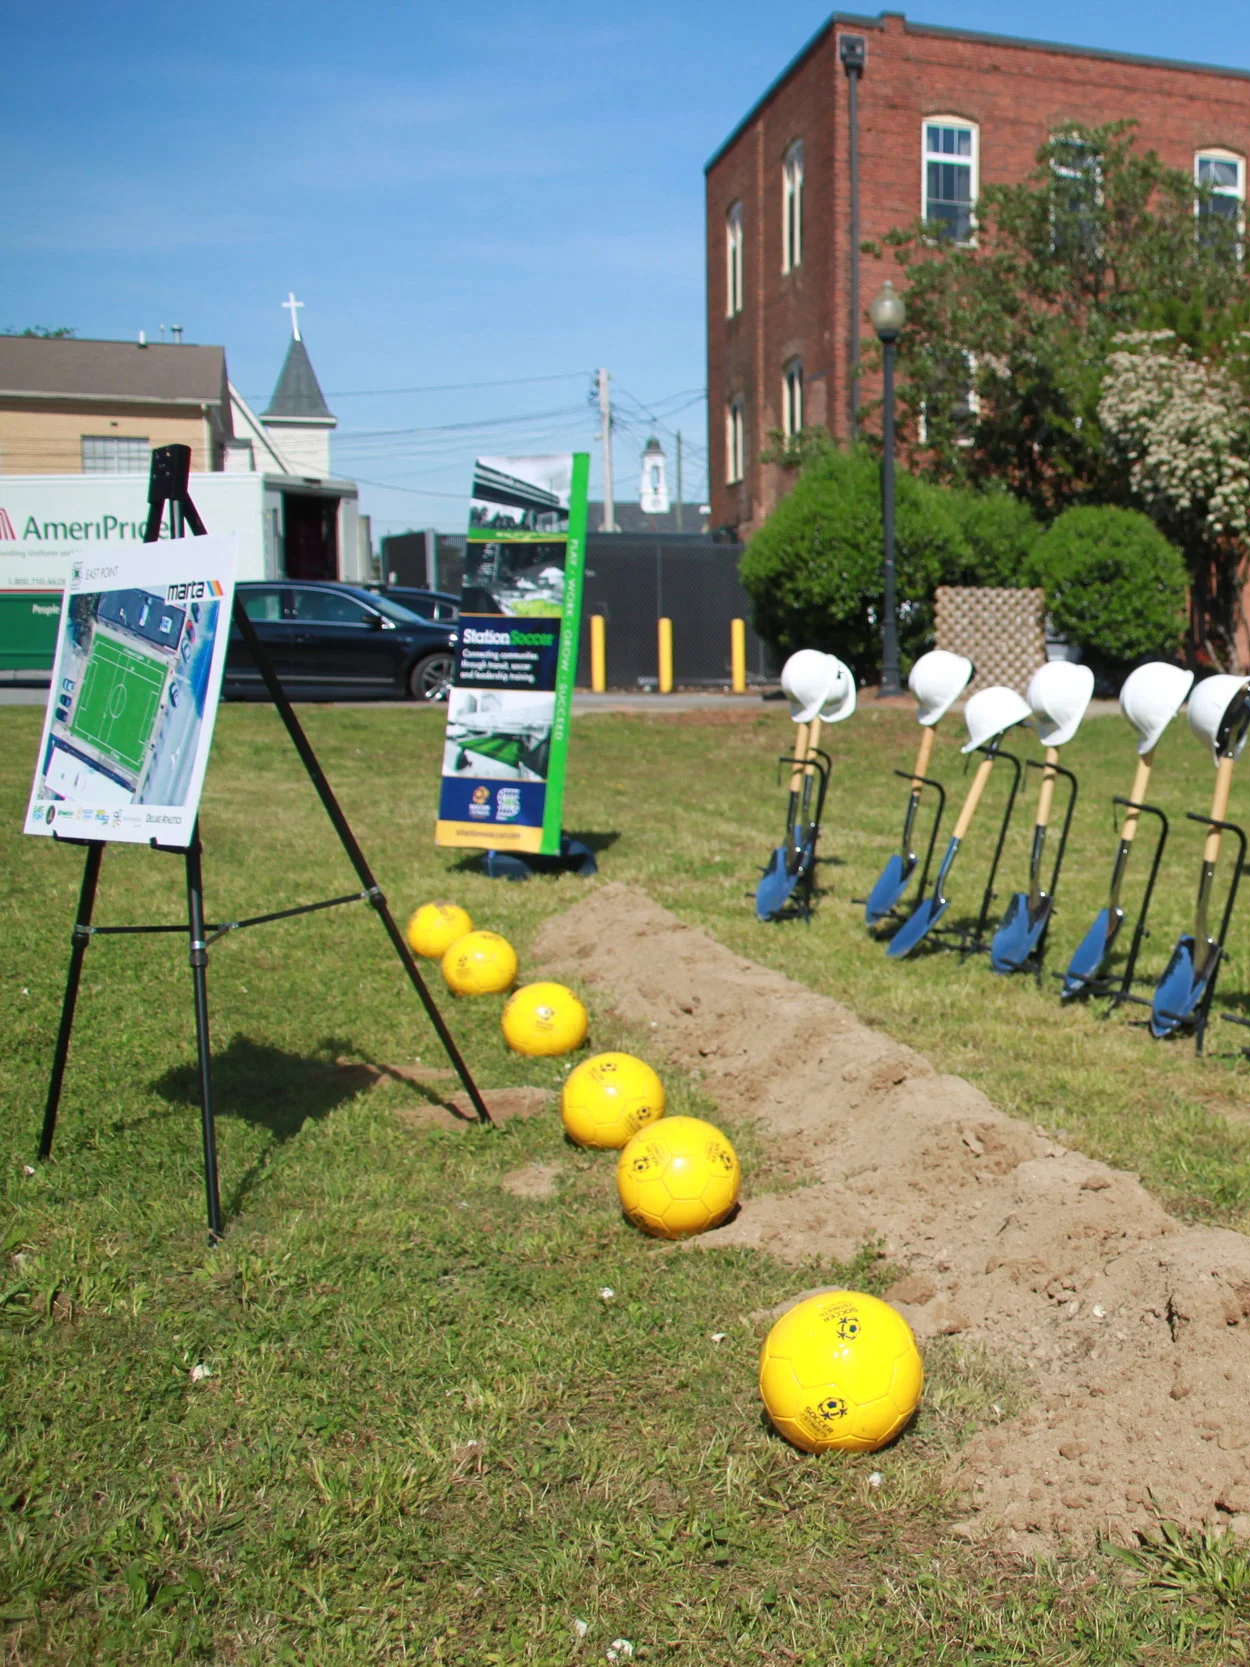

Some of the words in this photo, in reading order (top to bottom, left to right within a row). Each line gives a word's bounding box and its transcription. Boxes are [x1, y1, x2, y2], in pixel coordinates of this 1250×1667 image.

[167, 580, 205, 601] marta
[32, 604, 61, 616] People
[561, 629, 573, 672] GROW
[805, 1406, 834, 1435] SOCCER
